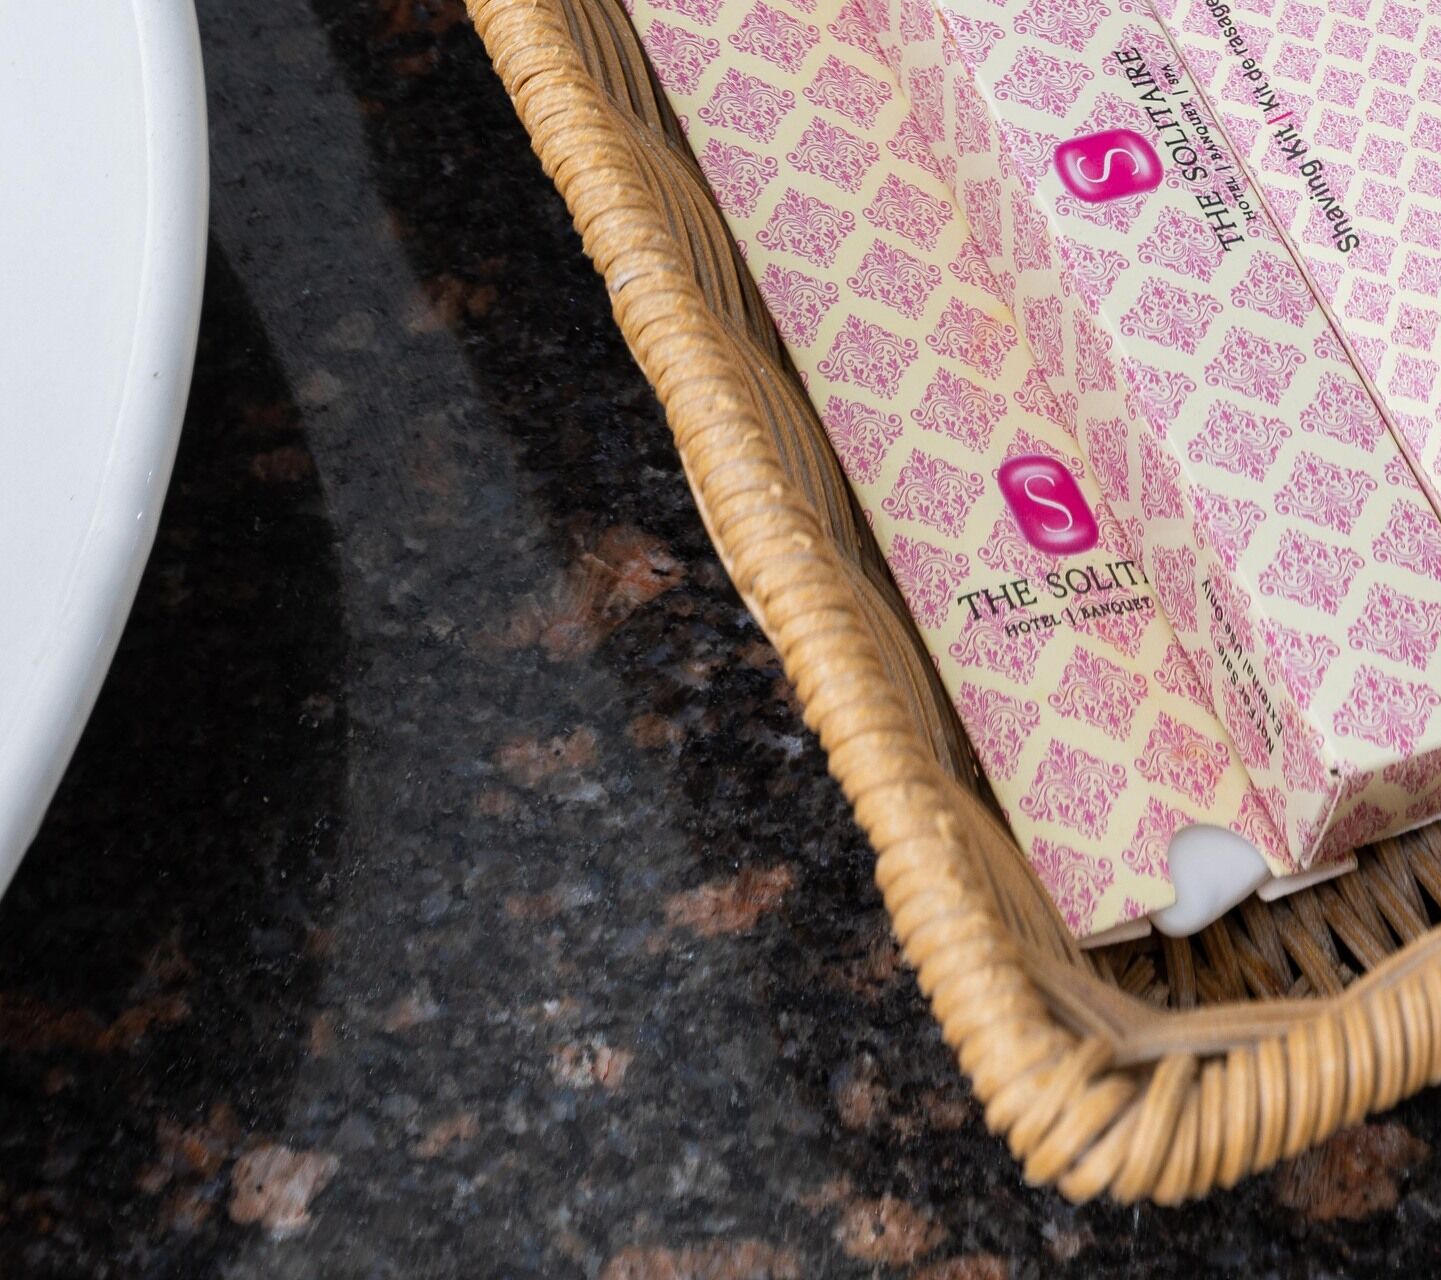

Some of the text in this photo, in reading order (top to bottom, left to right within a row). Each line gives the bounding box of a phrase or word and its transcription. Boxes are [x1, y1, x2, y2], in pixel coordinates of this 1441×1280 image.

[1242, 58, 1262, 81] de
[1252, 82, 1280, 112] Kit
[1115, 47, 1245, 252] THE SOLITAIRE
[1161, 64, 1256, 220] HOTEL BANQUET SPA
[1274, 123, 1307, 161] Kit
[1301, 159, 1360, 253] Shaving
[957, 561, 1149, 621] THE SOLIT
[1004, 597, 1152, 638] HOTEL BANQUET
[1202, 579, 1283, 737] External Use Only
[1217, 645, 1274, 755] Not For Sale
